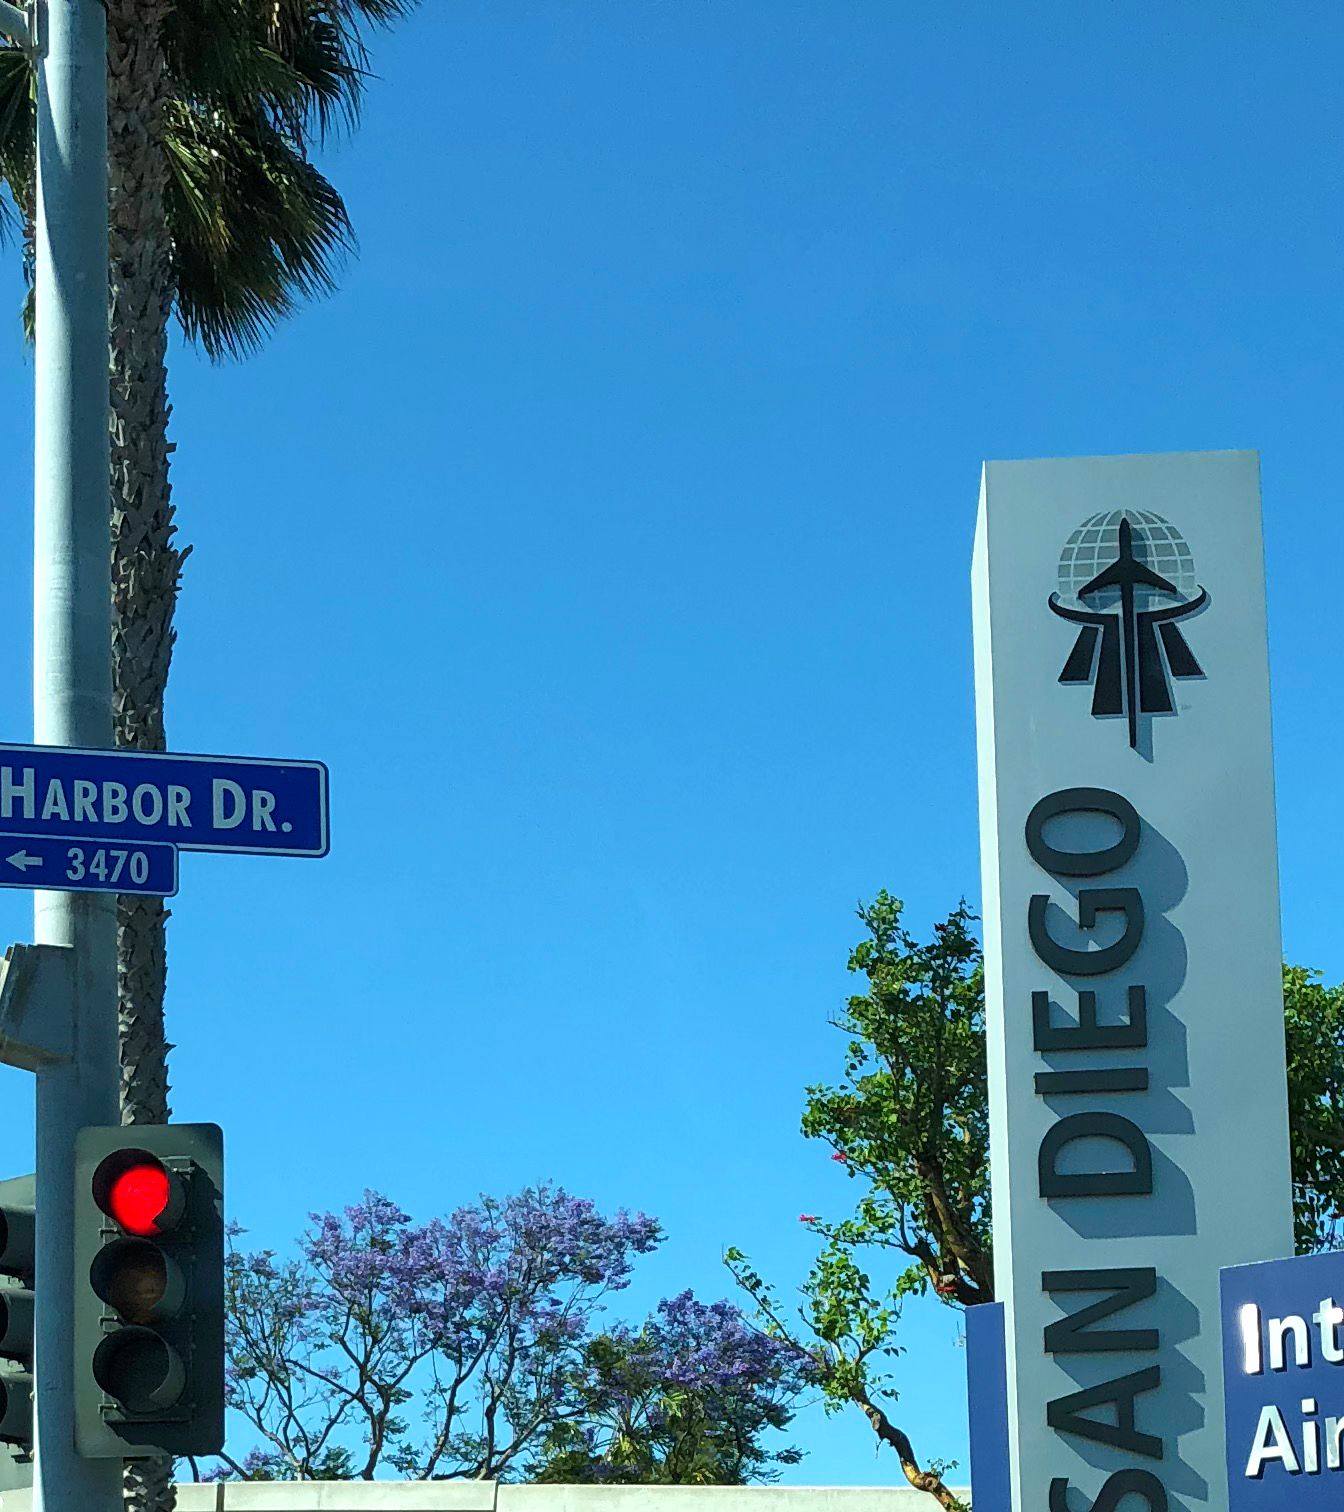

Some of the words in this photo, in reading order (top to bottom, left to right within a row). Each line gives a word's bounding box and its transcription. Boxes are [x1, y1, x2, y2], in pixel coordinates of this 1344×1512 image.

[0, 767, 191, 827] HARBOR
[66, 848, 148, 885] 3470
[1025, 787, 1153, 1198] DIEGO
